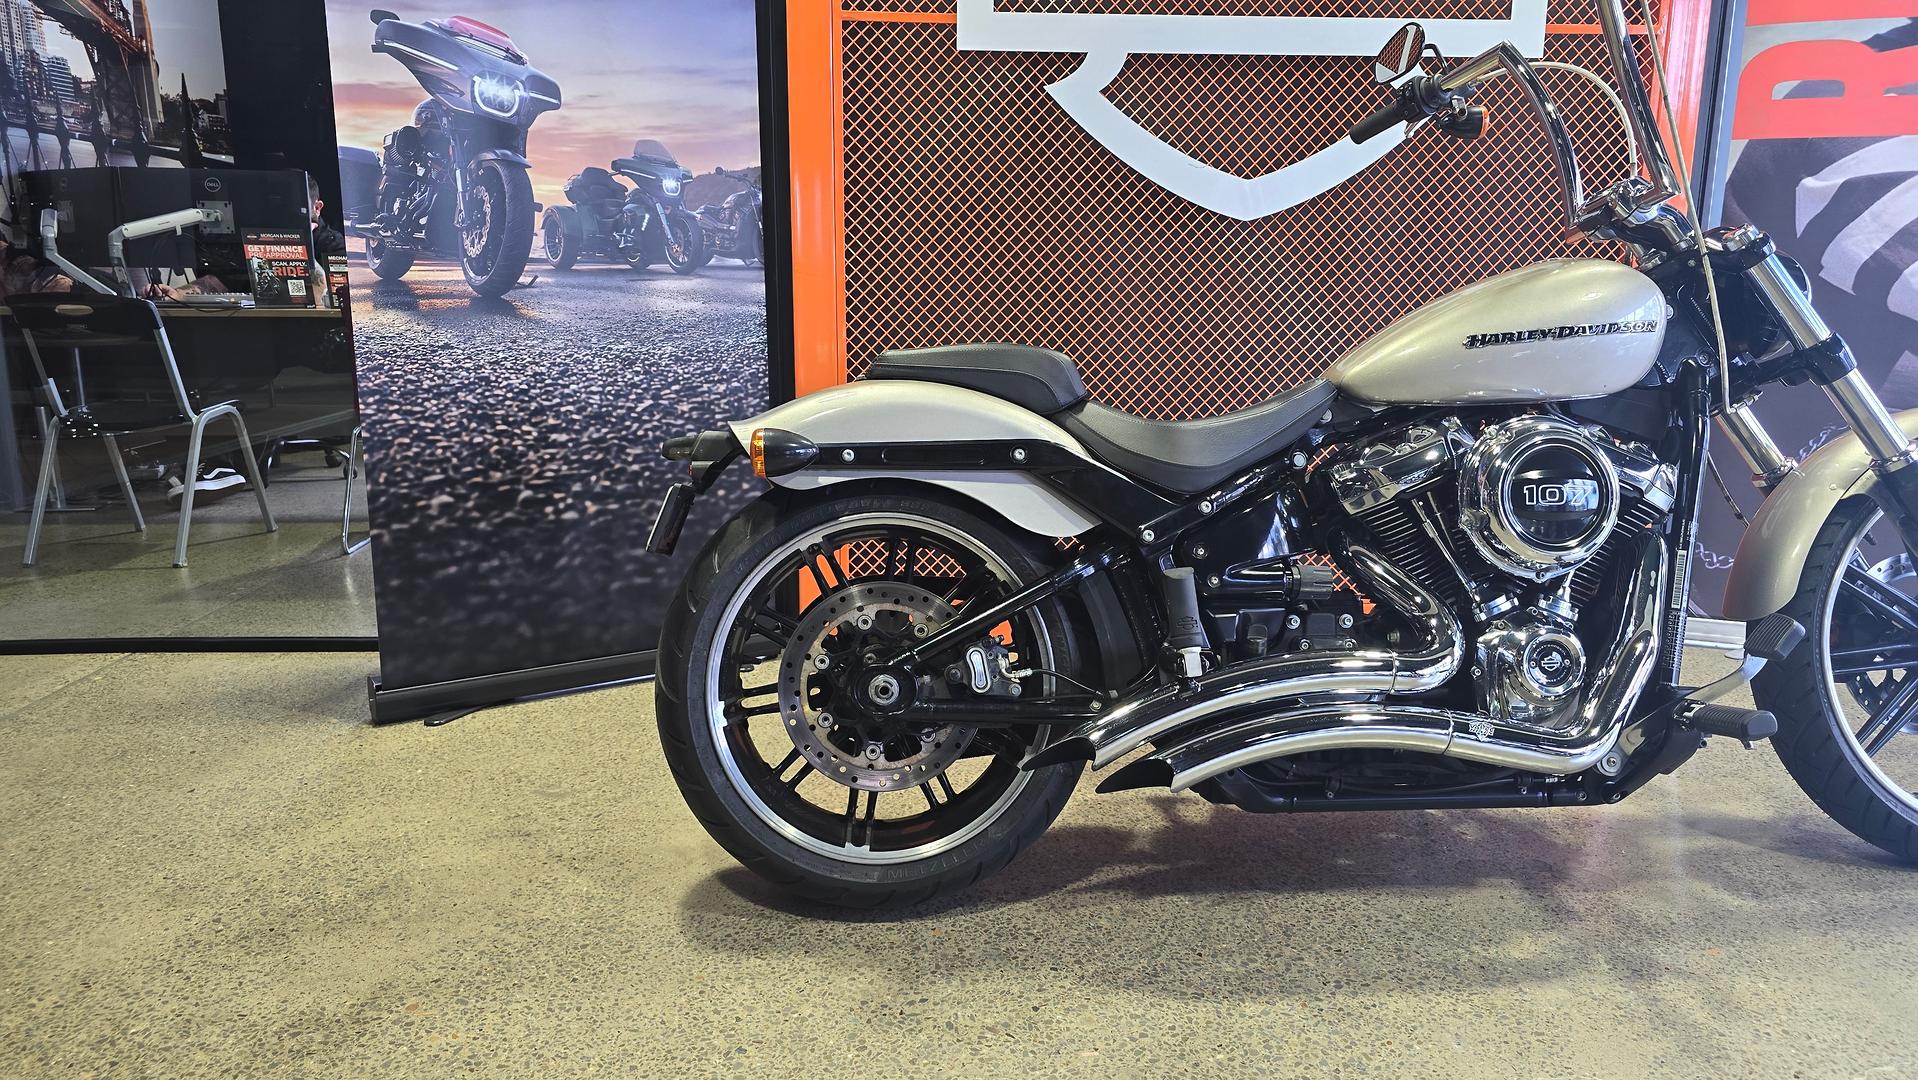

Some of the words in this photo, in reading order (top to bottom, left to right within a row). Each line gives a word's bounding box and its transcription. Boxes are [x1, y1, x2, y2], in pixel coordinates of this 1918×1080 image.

[266, 245, 303, 253] FINANCE
[274, 266, 309, 277] RIDE.
[1462, 320, 1658, 349] HARLEY-DAVIDSON
[1523, 484, 1592, 506] 107
